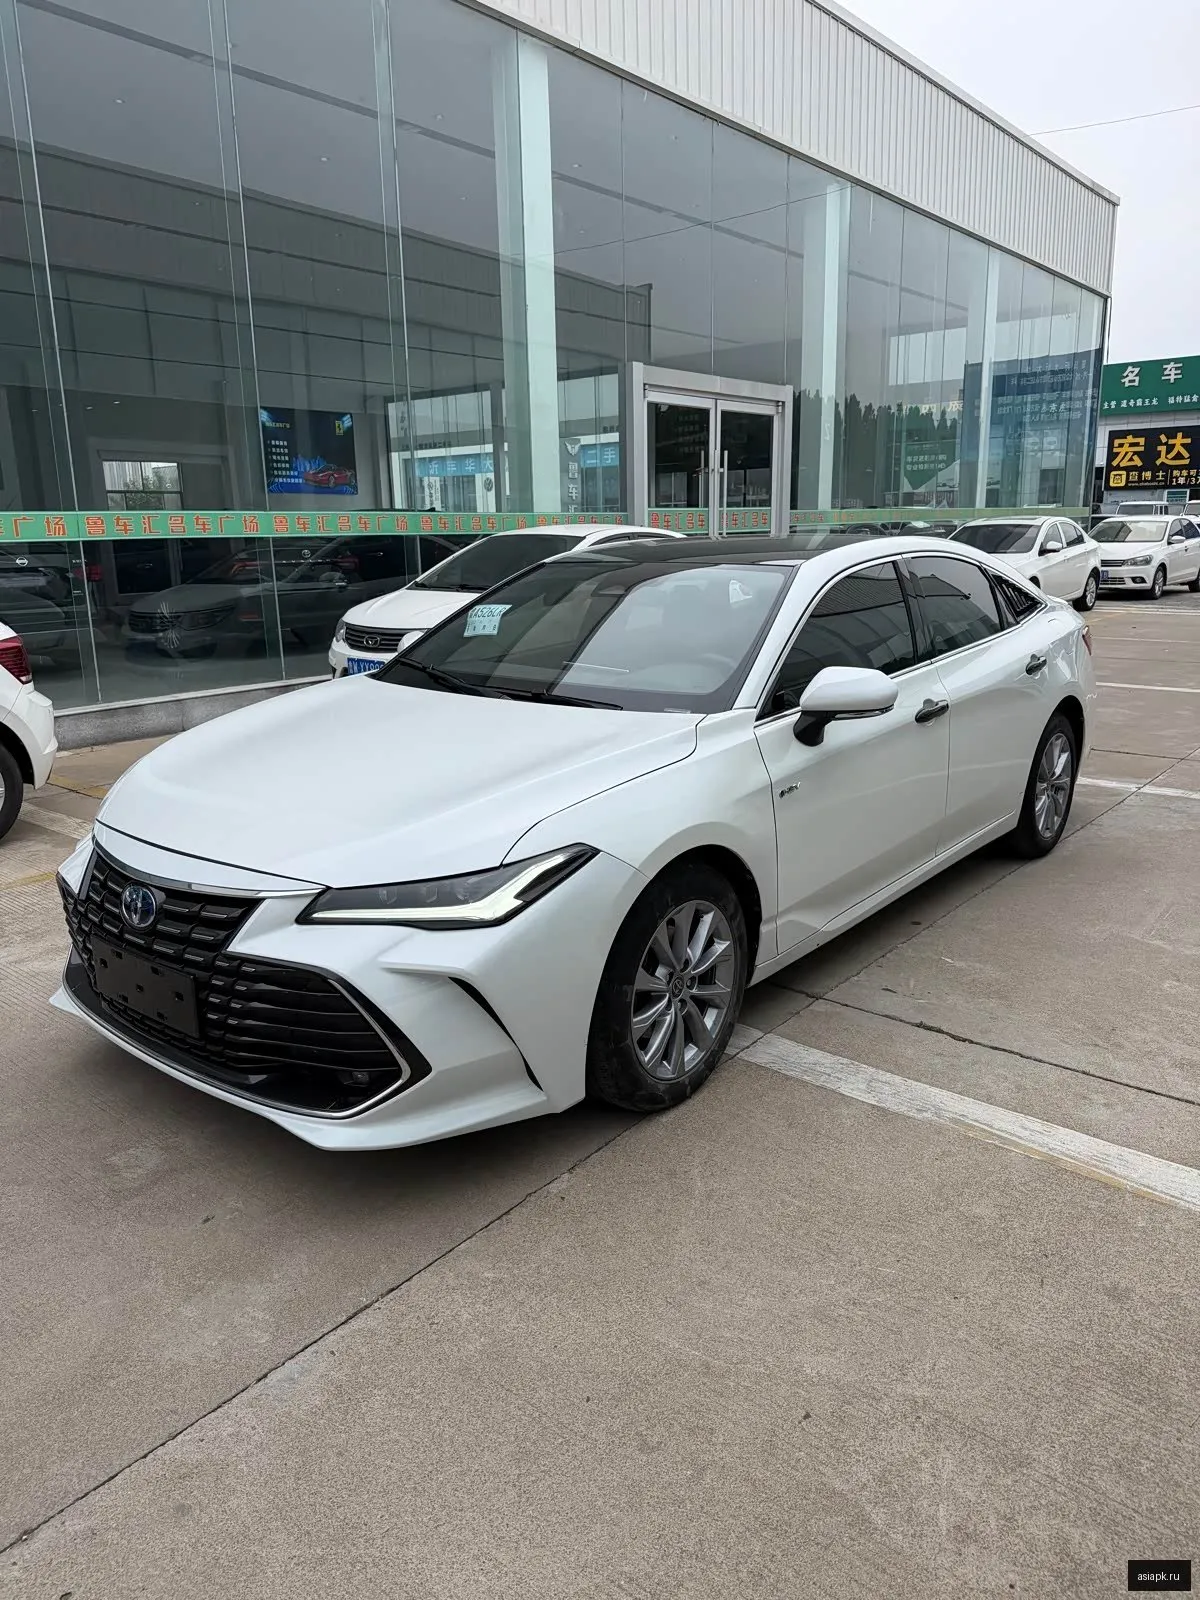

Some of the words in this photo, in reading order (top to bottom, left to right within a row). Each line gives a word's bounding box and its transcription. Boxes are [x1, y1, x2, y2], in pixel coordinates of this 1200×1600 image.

[1121, 361, 1183, 388] 名车
[1111, 431, 1192, 467] 宏达
[1128, 470, 1166, 482] 查博士
[0, 515, 68, 537] 广场
[85, 514, 259, 537] 鲁车汇名车广场
[273, 514, 409, 534] 鲁车汇名车广场
[420, 514, 527, 532] 鲁车汇名车广场
